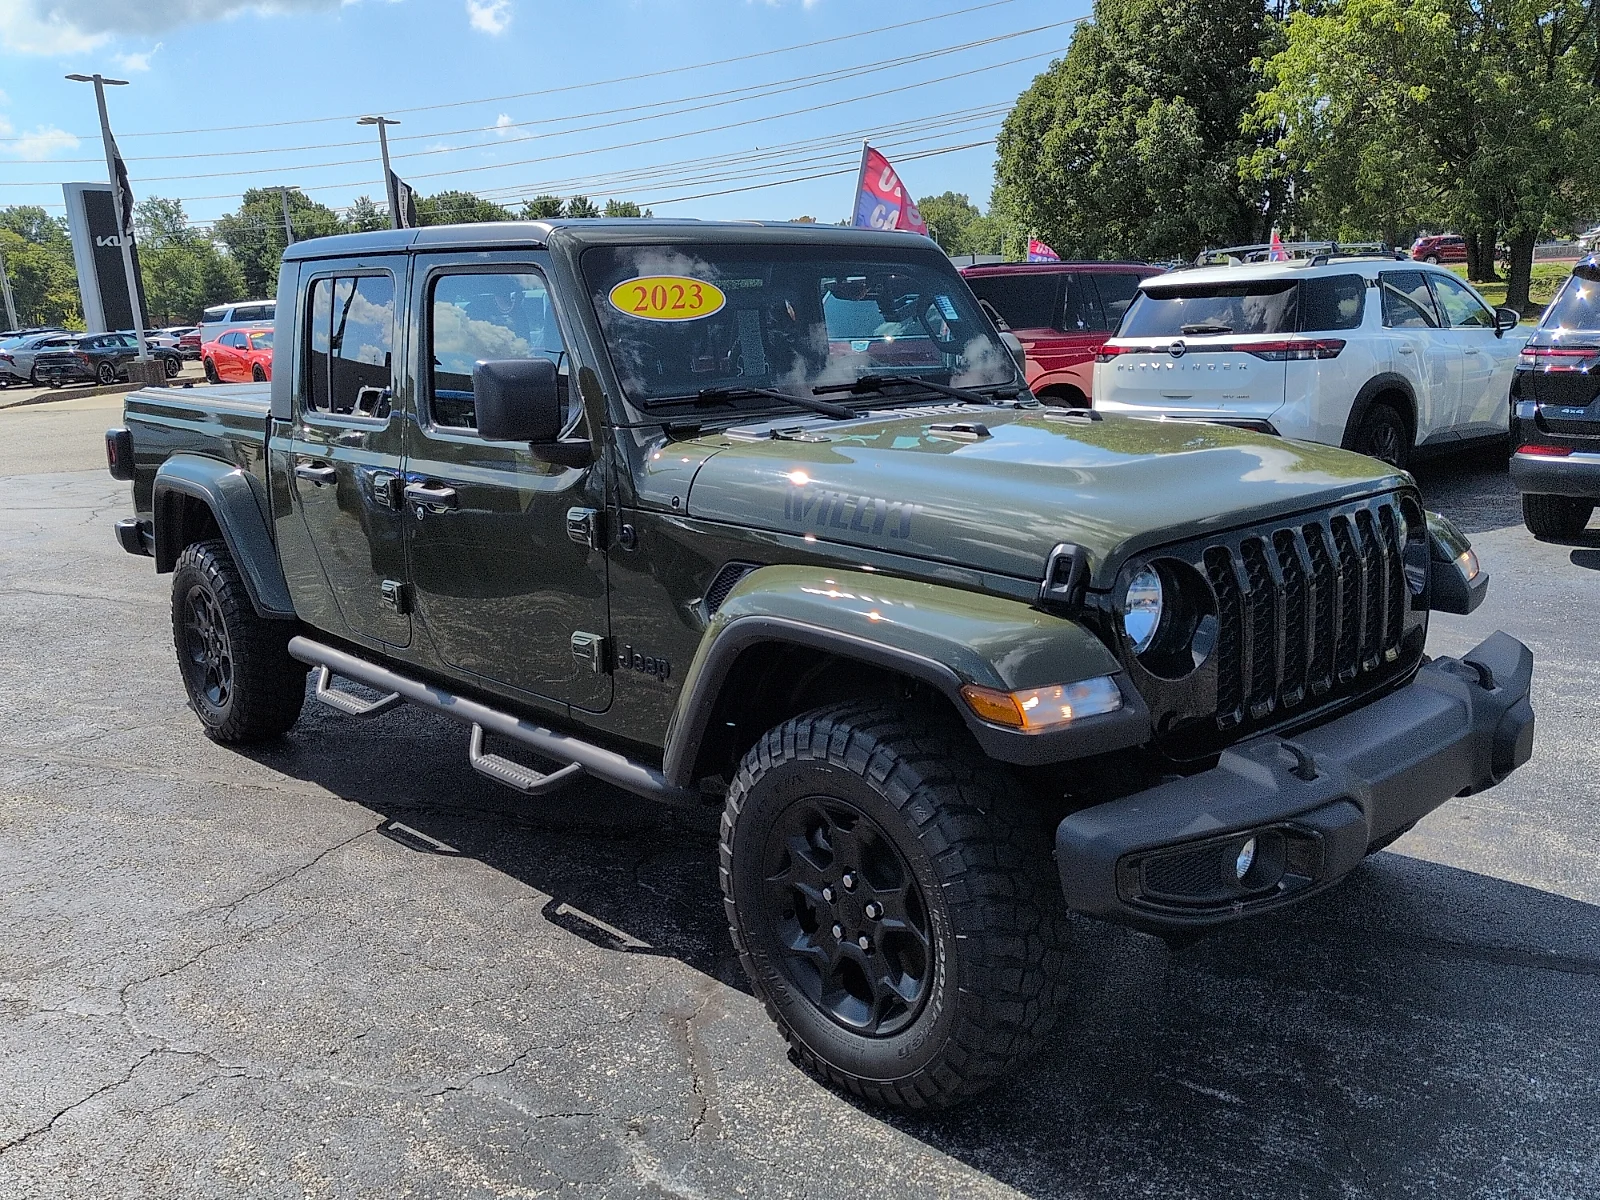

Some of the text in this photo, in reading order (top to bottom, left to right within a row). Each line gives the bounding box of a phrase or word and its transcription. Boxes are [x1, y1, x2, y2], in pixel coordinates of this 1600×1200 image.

[632, 284, 704, 311] 2023
[1117, 362, 1248, 371] PATHFINDER
[784, 487, 924, 539] WILLYS
[618, 644, 671, 683] Jeep
